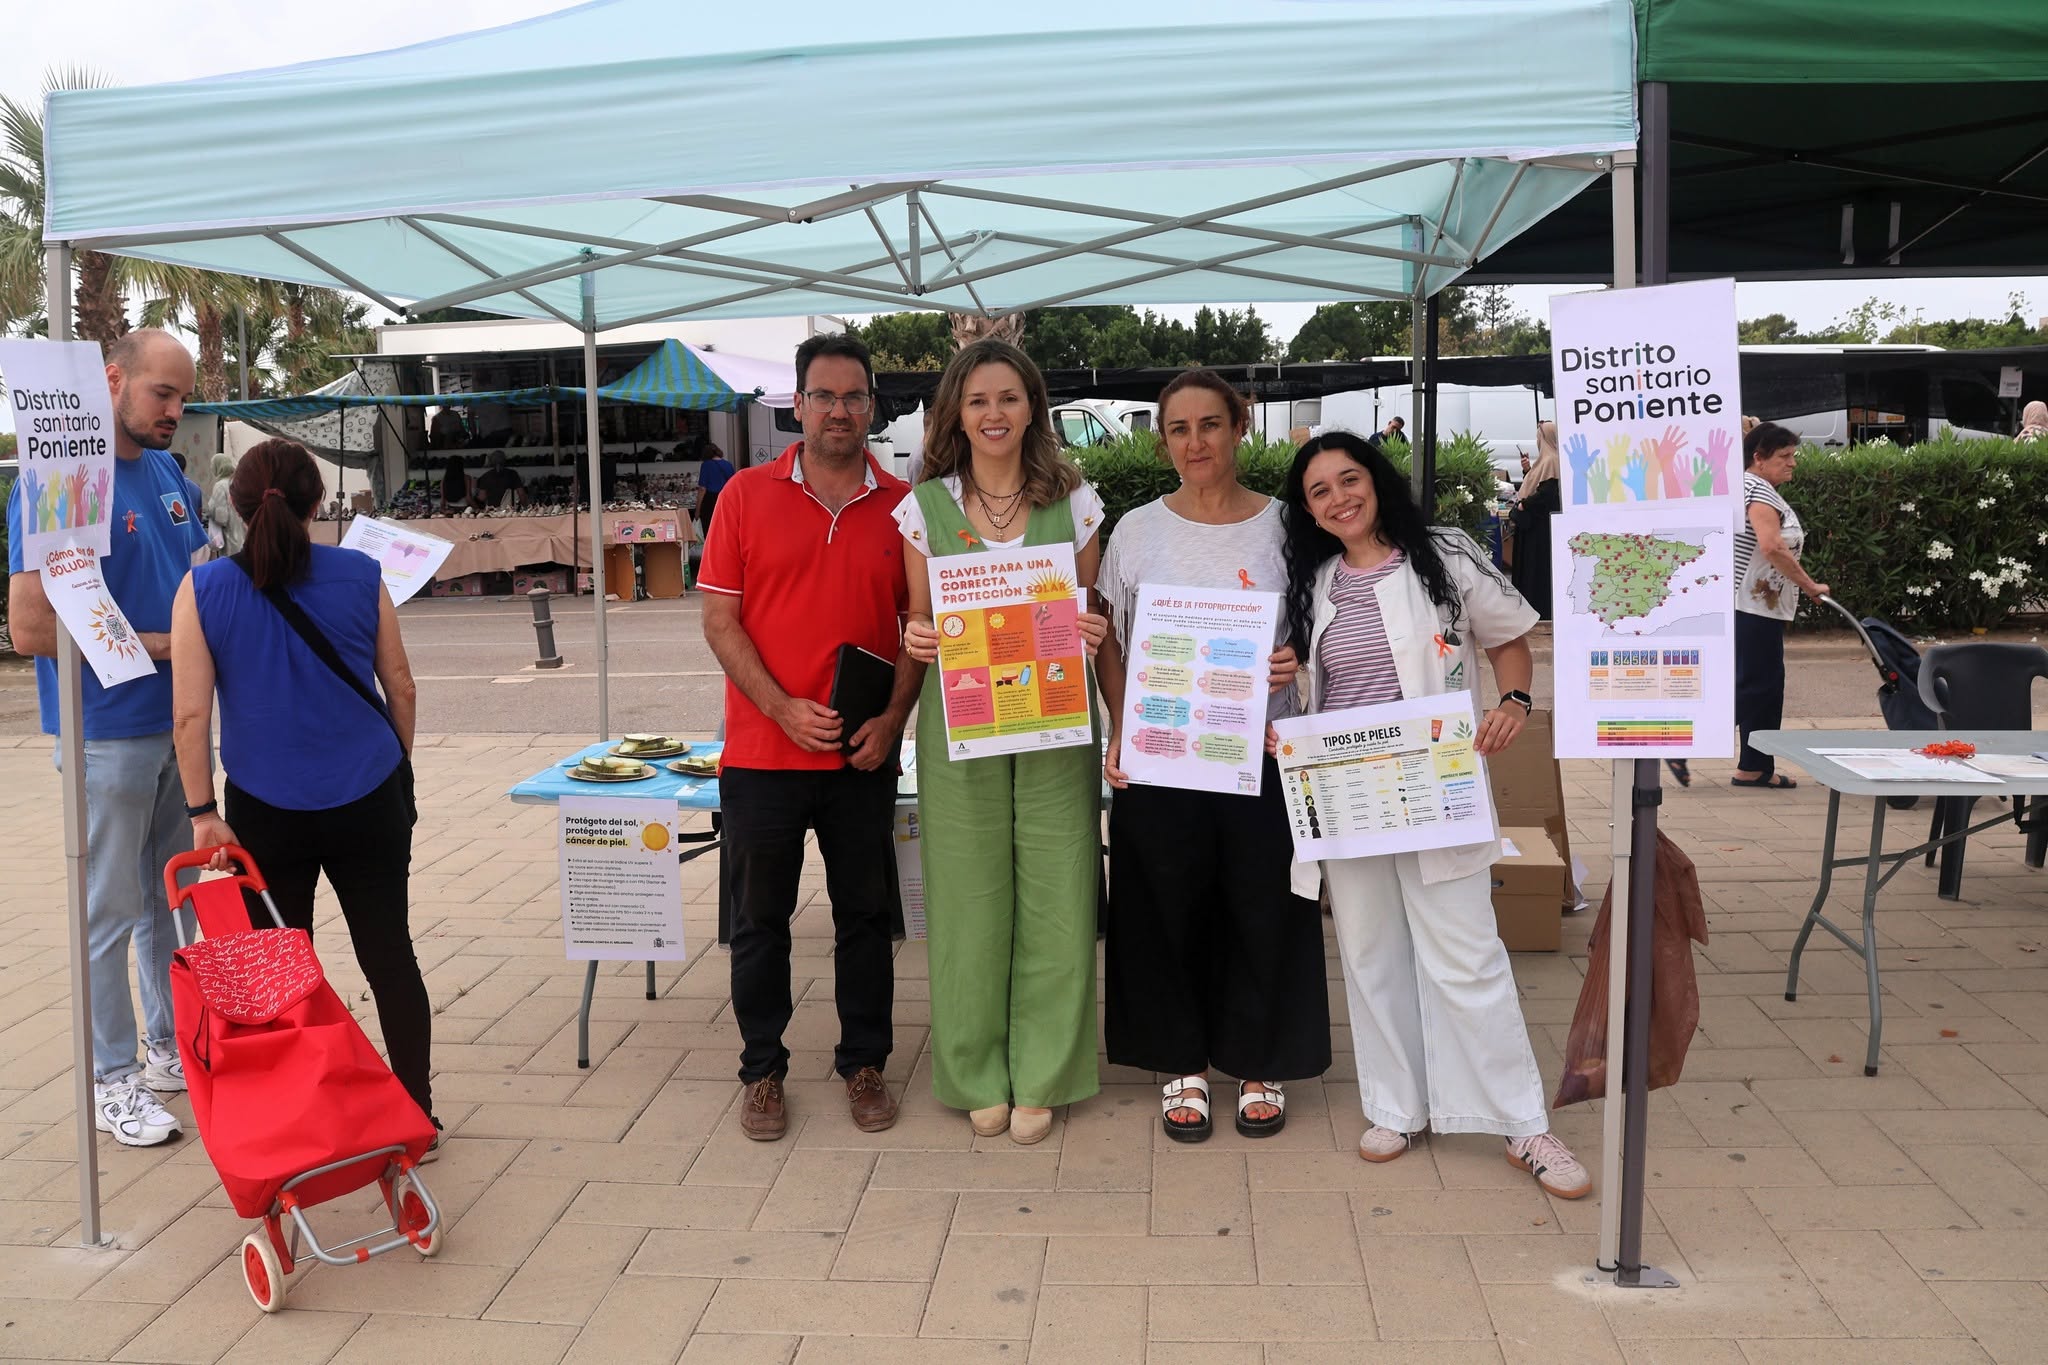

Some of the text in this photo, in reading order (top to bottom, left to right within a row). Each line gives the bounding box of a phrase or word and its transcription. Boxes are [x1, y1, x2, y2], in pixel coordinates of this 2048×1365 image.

[1562, 342, 1676, 372] Distrito
[1586, 365, 1710, 394] sanitario
[13, 389, 80, 411] Distrito
[1574, 392, 1722, 424] Poniente
[33, 412, 100, 432] sanitario
[28, 434, 106, 460] Poniente
[939, 558, 1054, 580] CLAVES PARA UNA
[940, 577, 1008, 592] CORRECTA
[942, 582, 1066, 604] PROTECCIÓN SOLAR
[1152, 597, 1172, 608] ¿QUÉ
[1194, 601, 1262, 614] FOTOPROTECCIÓN?
[1614, 656, 1620, 665] 3
[1623, 656, 1630, 665] 4
[1632, 656, 1638, 665] 5
[1642, 656, 1648, 665] 6
[1651, 655, 1657, 664] 7
[1322, 726, 1401, 748] TIPOS DE PIELES
[566, 816, 607, 826] Protégete
[566, 827, 608, 836] protégete
[610, 838, 628, 847] piel.
